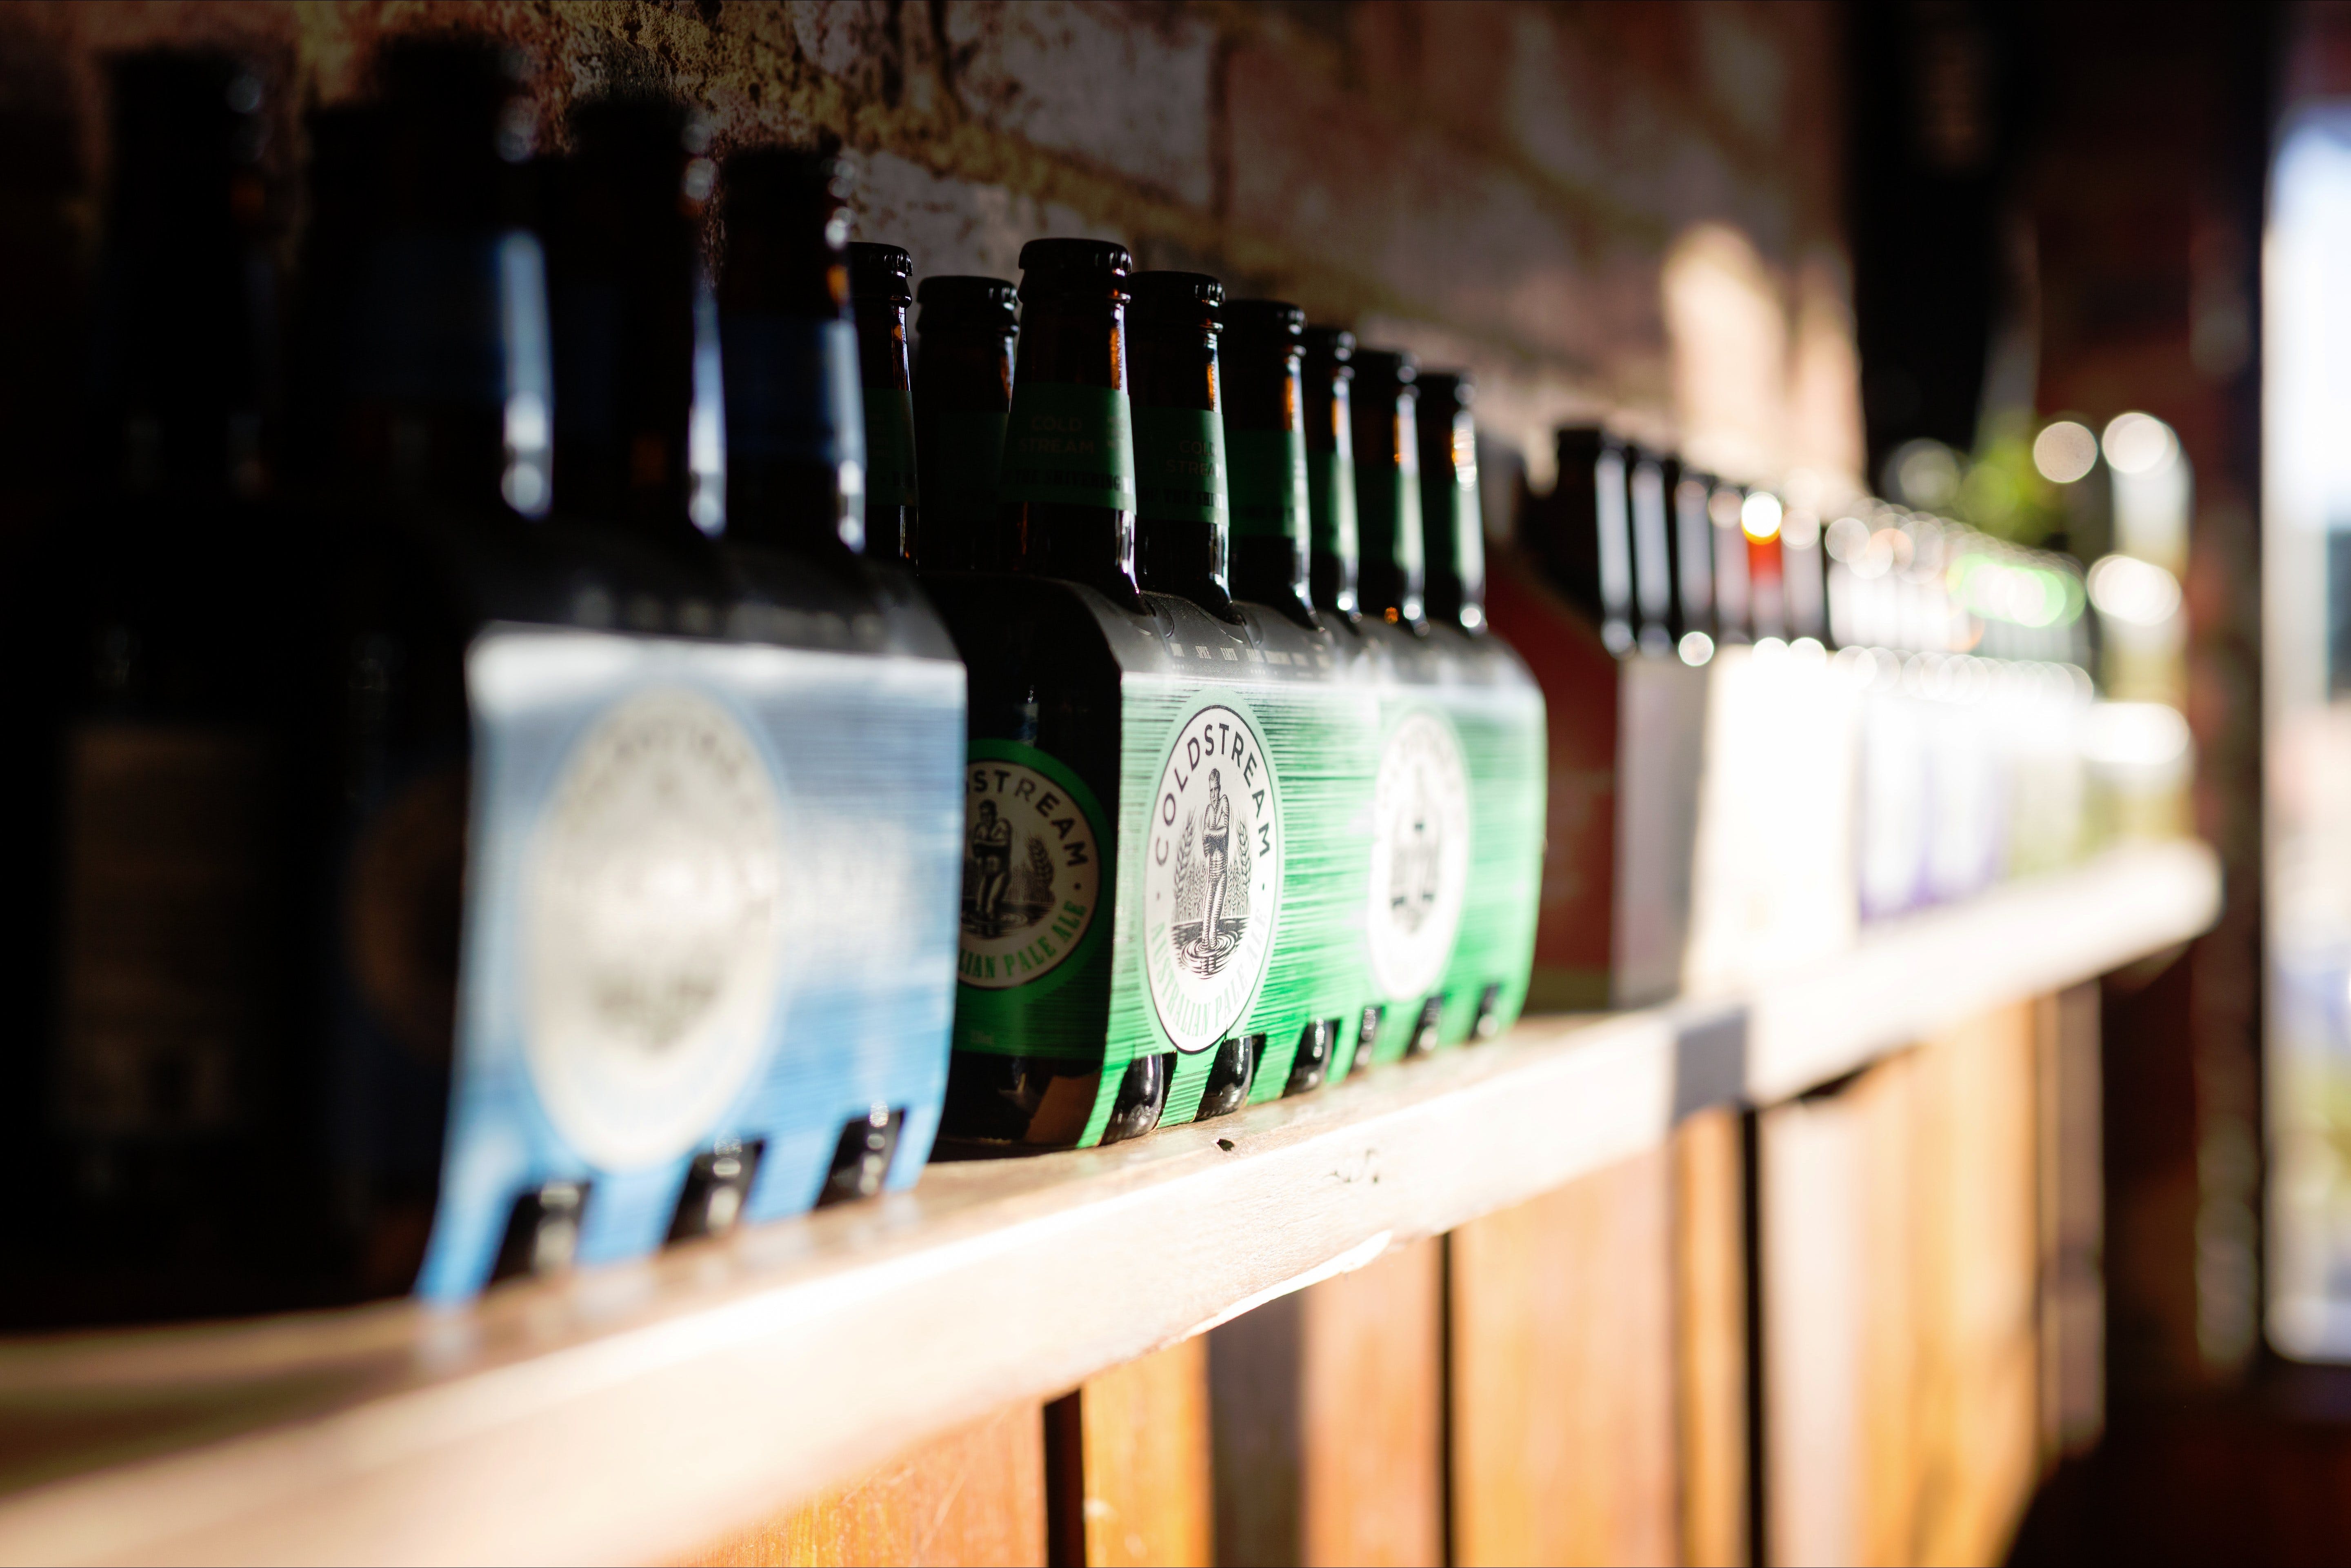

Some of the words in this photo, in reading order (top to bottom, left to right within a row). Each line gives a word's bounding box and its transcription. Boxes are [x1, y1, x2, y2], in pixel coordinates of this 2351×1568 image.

[1019, 438, 1094, 453] STREAM
[1031, 415, 1082, 432] COLD
[1195, 646, 1212, 659] SPICE
[966, 770, 1088, 866] STREAM
[1156, 723, 1271, 866] COLDSTREAM
[1003, 936, 1057, 976] PALE
[1051, 900, 1087, 943] ALE
[1151, 921, 1211, 1037] AUSTRALIAN
[1214, 963, 1247, 1029] PALE
[1246, 908, 1267, 962] ALE
